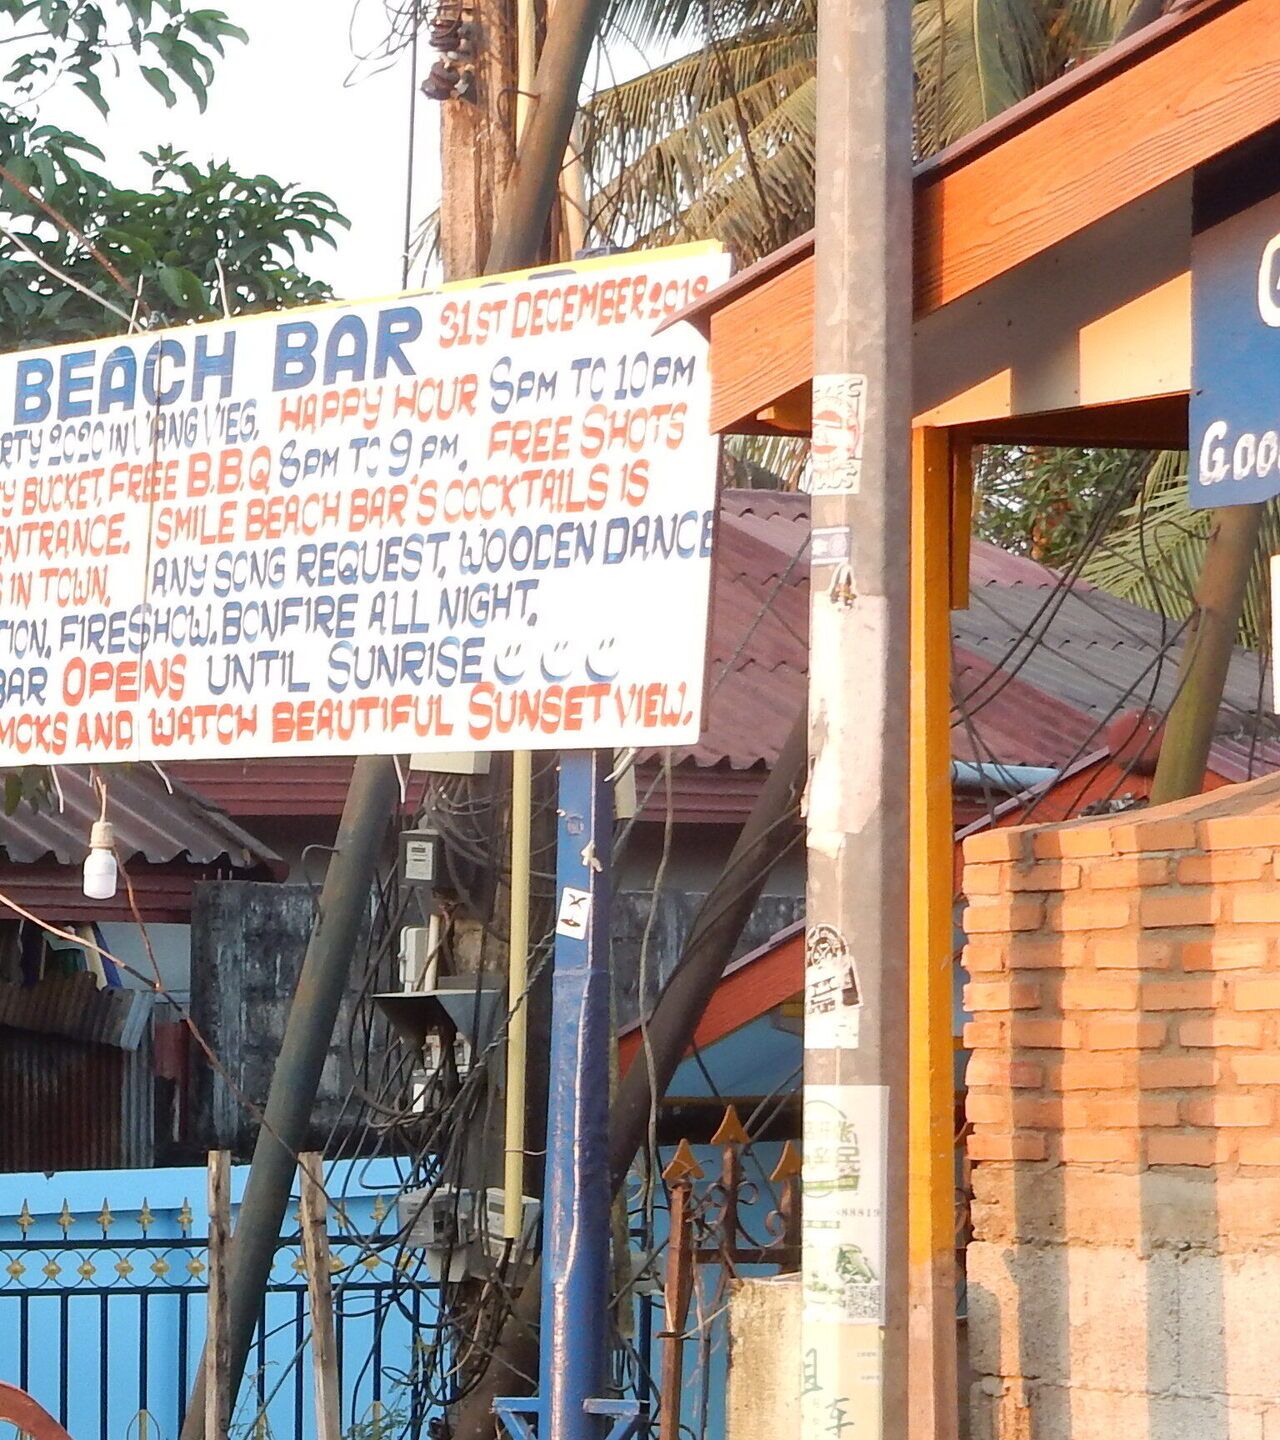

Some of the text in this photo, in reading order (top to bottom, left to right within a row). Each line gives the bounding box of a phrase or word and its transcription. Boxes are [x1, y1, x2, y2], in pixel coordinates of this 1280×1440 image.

[439, 299, 508, 350] 31ST
[510, 274, 648, 339] DECEMBER
[13, 330, 237, 426] BEACH
[272, 305, 424, 393] BAR
[47, 420, 106, 467] 2020
[109, 419, 129, 457] IN
[278, 384, 382, 435] HAPPY
[393, 373, 479, 423] HOUR
[570, 356, 607, 402] TO
[108, 460, 180, 505] FREE
[349, 436, 381, 477] TO
[387, 428, 414, 477] 9
[487, 415, 573, 464] FREE
[579, 402, 688, 460] SHOTS
[155, 500, 239, 550] SMILE
[244, 490, 342, 542] BEACH
[348, 473, 438, 533] BAR'S
[442, 462, 609, 525] COCKTAILS
[619, 458, 651, 508] IS
[10, 565, 34, 610] IN
[151, 553, 208, 598] ANY
[212, 546, 287, 599] SONG
[458, 519, 598, 577] WOODEN
[602, 509, 714, 566] DANCE
[221, 593, 359, 646] BONFIRE
[367, 589, 430, 637] ALL
[62, 652, 188, 707] OPENS
[206, 649, 311, 696] UNTIL
[326, 635, 486, 694] SUNRISE
[75, 709, 134, 751] AND
[147, 702, 259, 748] WATCH
[271, 693, 455, 744] BEAUTIFUL
[466, 681, 612, 742] SUNSET
